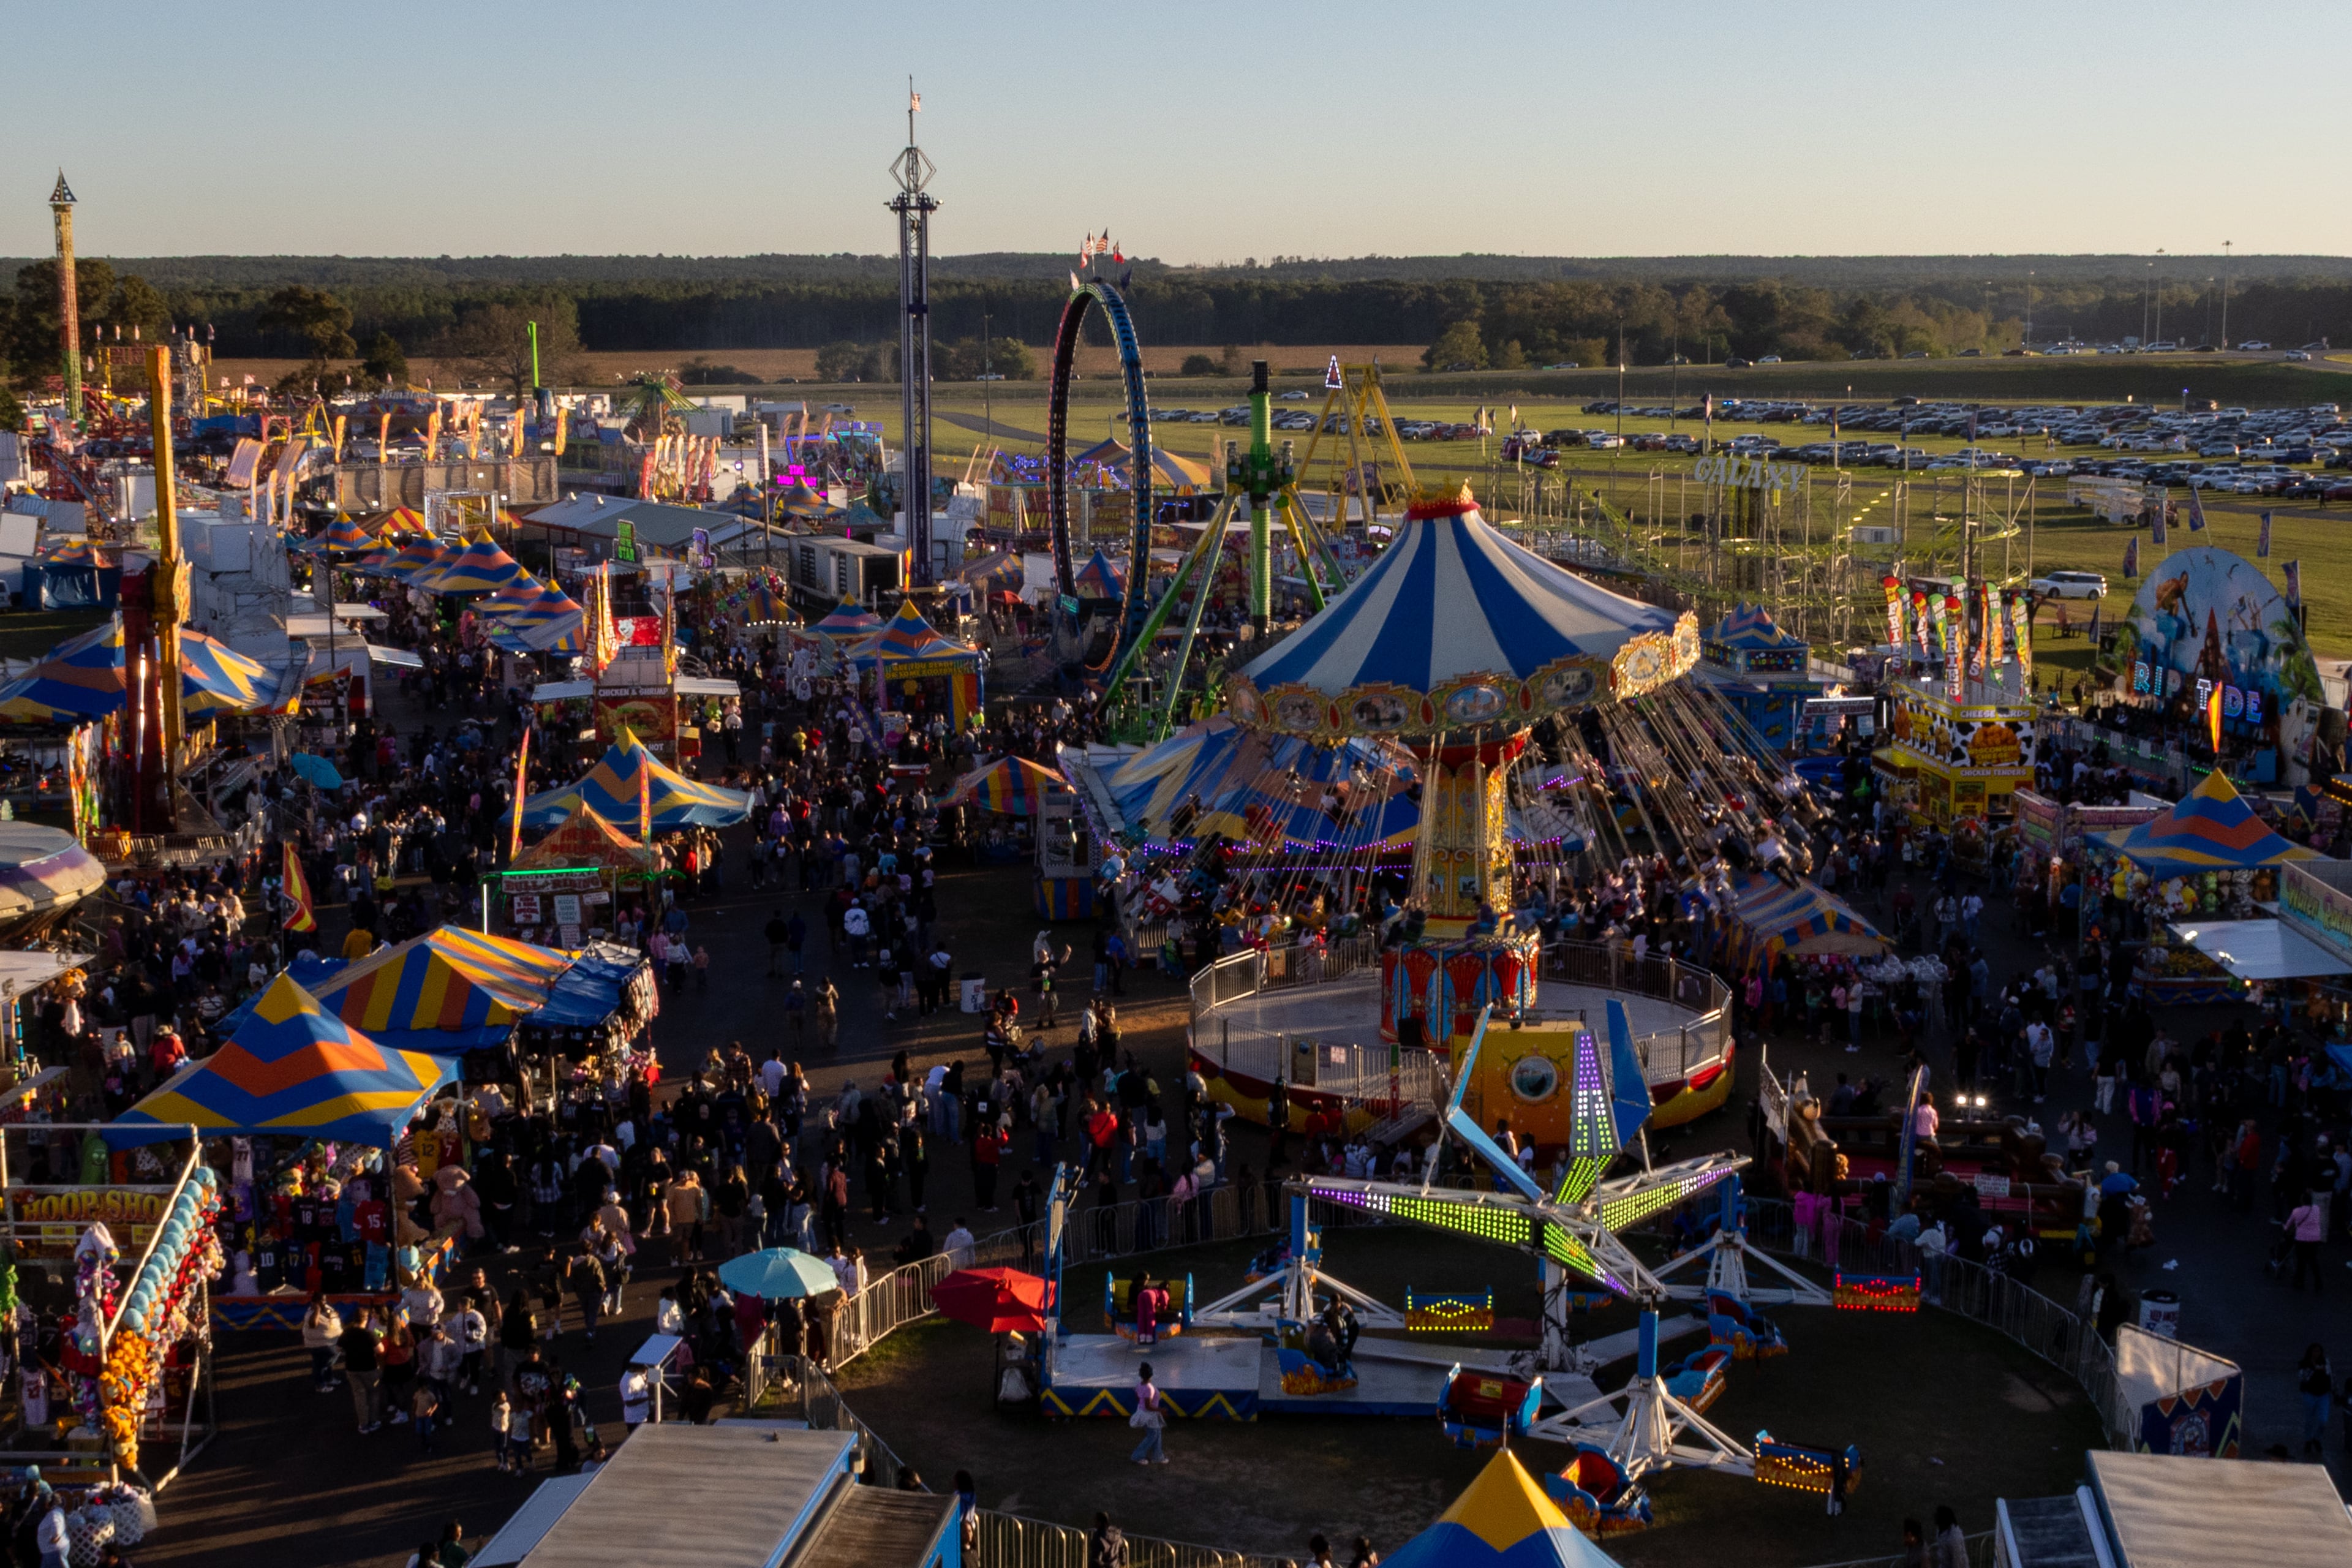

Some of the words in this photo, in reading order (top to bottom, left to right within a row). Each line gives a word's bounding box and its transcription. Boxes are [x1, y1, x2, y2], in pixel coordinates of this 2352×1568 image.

[1694, 456, 1807, 492] GALAXY
[1341, 543, 1357, 554] ICEE
[1887, 601, 1902, 668] FRIES
[910, 662, 927, 671] YOU
[598, 688, 630, 696] CHICKEN
[2133, 660, 2182, 698] RIP
[2195, 677, 2263, 723] TDE
[1960, 709, 1996, 718] CHEESE
[648, 742, 664, 751] HOT
[1967, 745, 2018, 755] WISCONSIN
[504, 879, 538, 891] BULL
[550, 875, 601, 890] RIDING
[236, 1151, 249, 1161] 77
[421, 1142, 434, 1157] 12
[445, 1144, 453, 1158] 7
[22, 1191, 98, 1222] HOOP
[105, 1189, 172, 1223] SHO
[302, 1211, 312, 1224] 18
[368, 1214, 381, 1229] 15
[260, 1252, 274, 1267] 10
[288, 1254, 300, 1268] 17
[45, 1333, 56, 1346] 7
